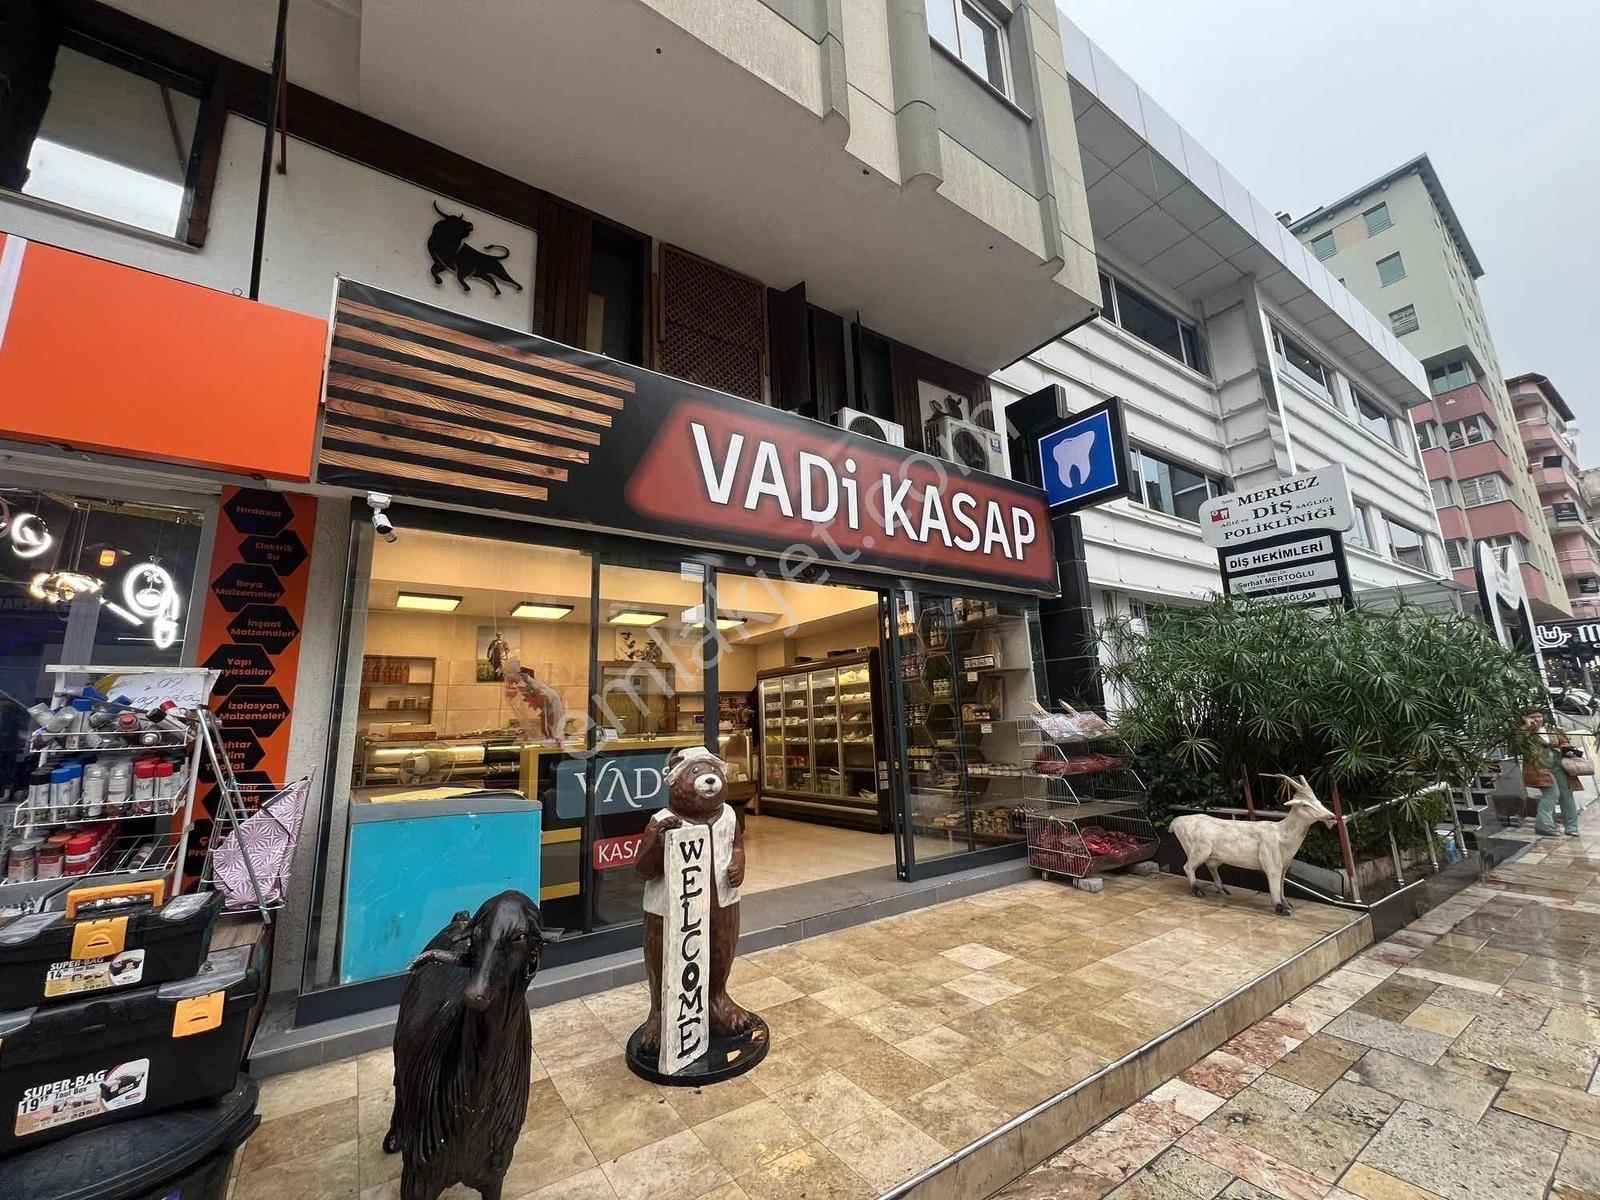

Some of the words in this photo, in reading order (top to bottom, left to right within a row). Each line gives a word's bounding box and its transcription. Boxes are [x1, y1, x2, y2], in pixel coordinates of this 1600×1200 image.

[1238, 476, 1320, 507] MERKEZ
[236, 505, 282, 518] Hırdavat
[883, 473, 1036, 561] KASAP
[1252, 500, 1293, 521] DİŞ
[1224, 505, 1337, 540] POLİKLİNİĞİ
[255, 542, 293, 552] Elektrik
[1230, 557, 1249, 569] DİŞ
[1252, 541, 1324, 565] HEKİMLERİ
[236, 580, 263, 590] Boya
[1237, 580, 1263, 589] Serhat
[1265, 570, 1315, 584] MERTOĞLU
[215, 588, 280, 598] Malzemeleri
[230, 628, 295, 638] Malzemeleri
[227, 658, 252, 667] Yapı
[219, 712, 286, 720] Malzemeleri
[574, 760, 670, 809] VAD
[677, 837, 705, 1060] WELCOME
[50, 957, 104, 971] SUPER-BAG
[23, 1069, 108, 1101] SUPER-BAG
[73, 1086, 87, 1095] Box
